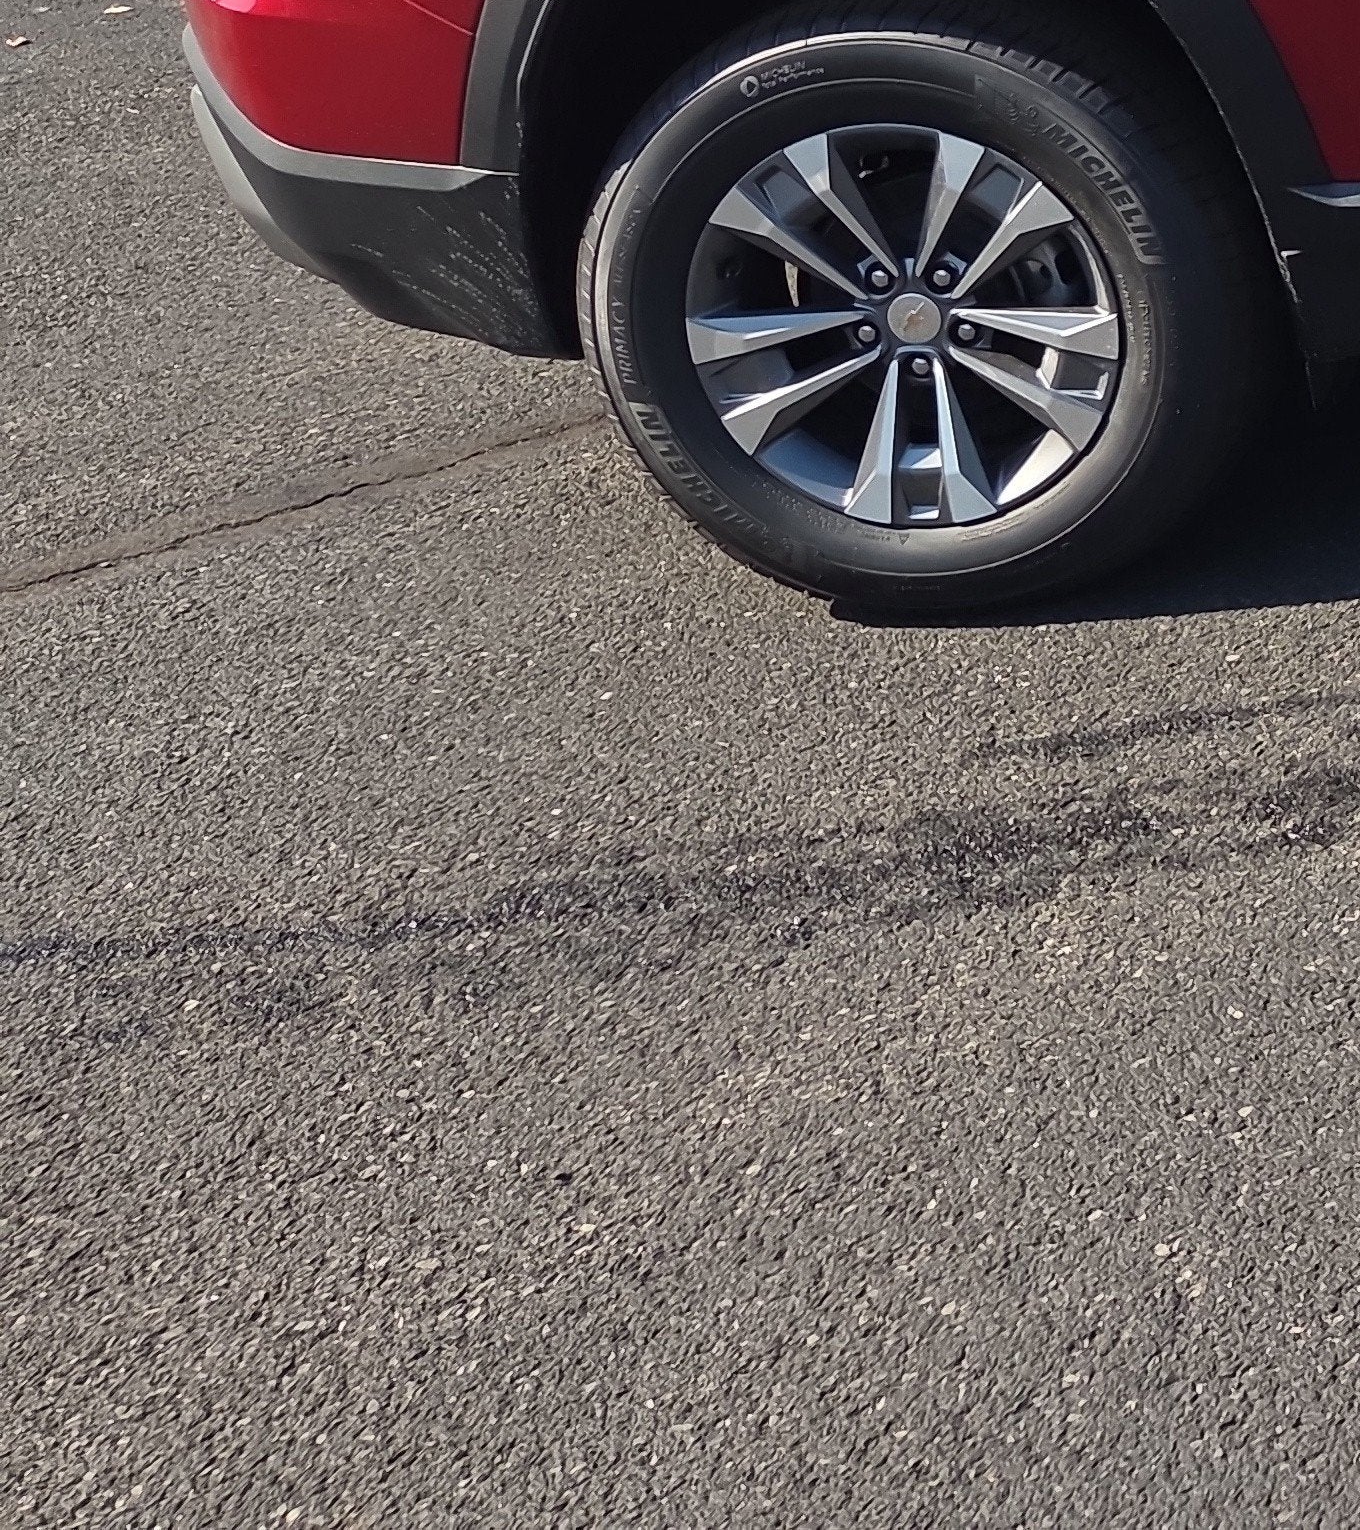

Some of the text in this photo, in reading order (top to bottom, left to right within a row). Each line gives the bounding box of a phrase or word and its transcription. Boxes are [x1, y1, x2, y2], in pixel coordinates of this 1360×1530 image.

[1043, 121, 1163, 259] MICHELIN
[610, 299, 638, 386] PRIMACY
[632, 408, 760, 538] MICHELIN
